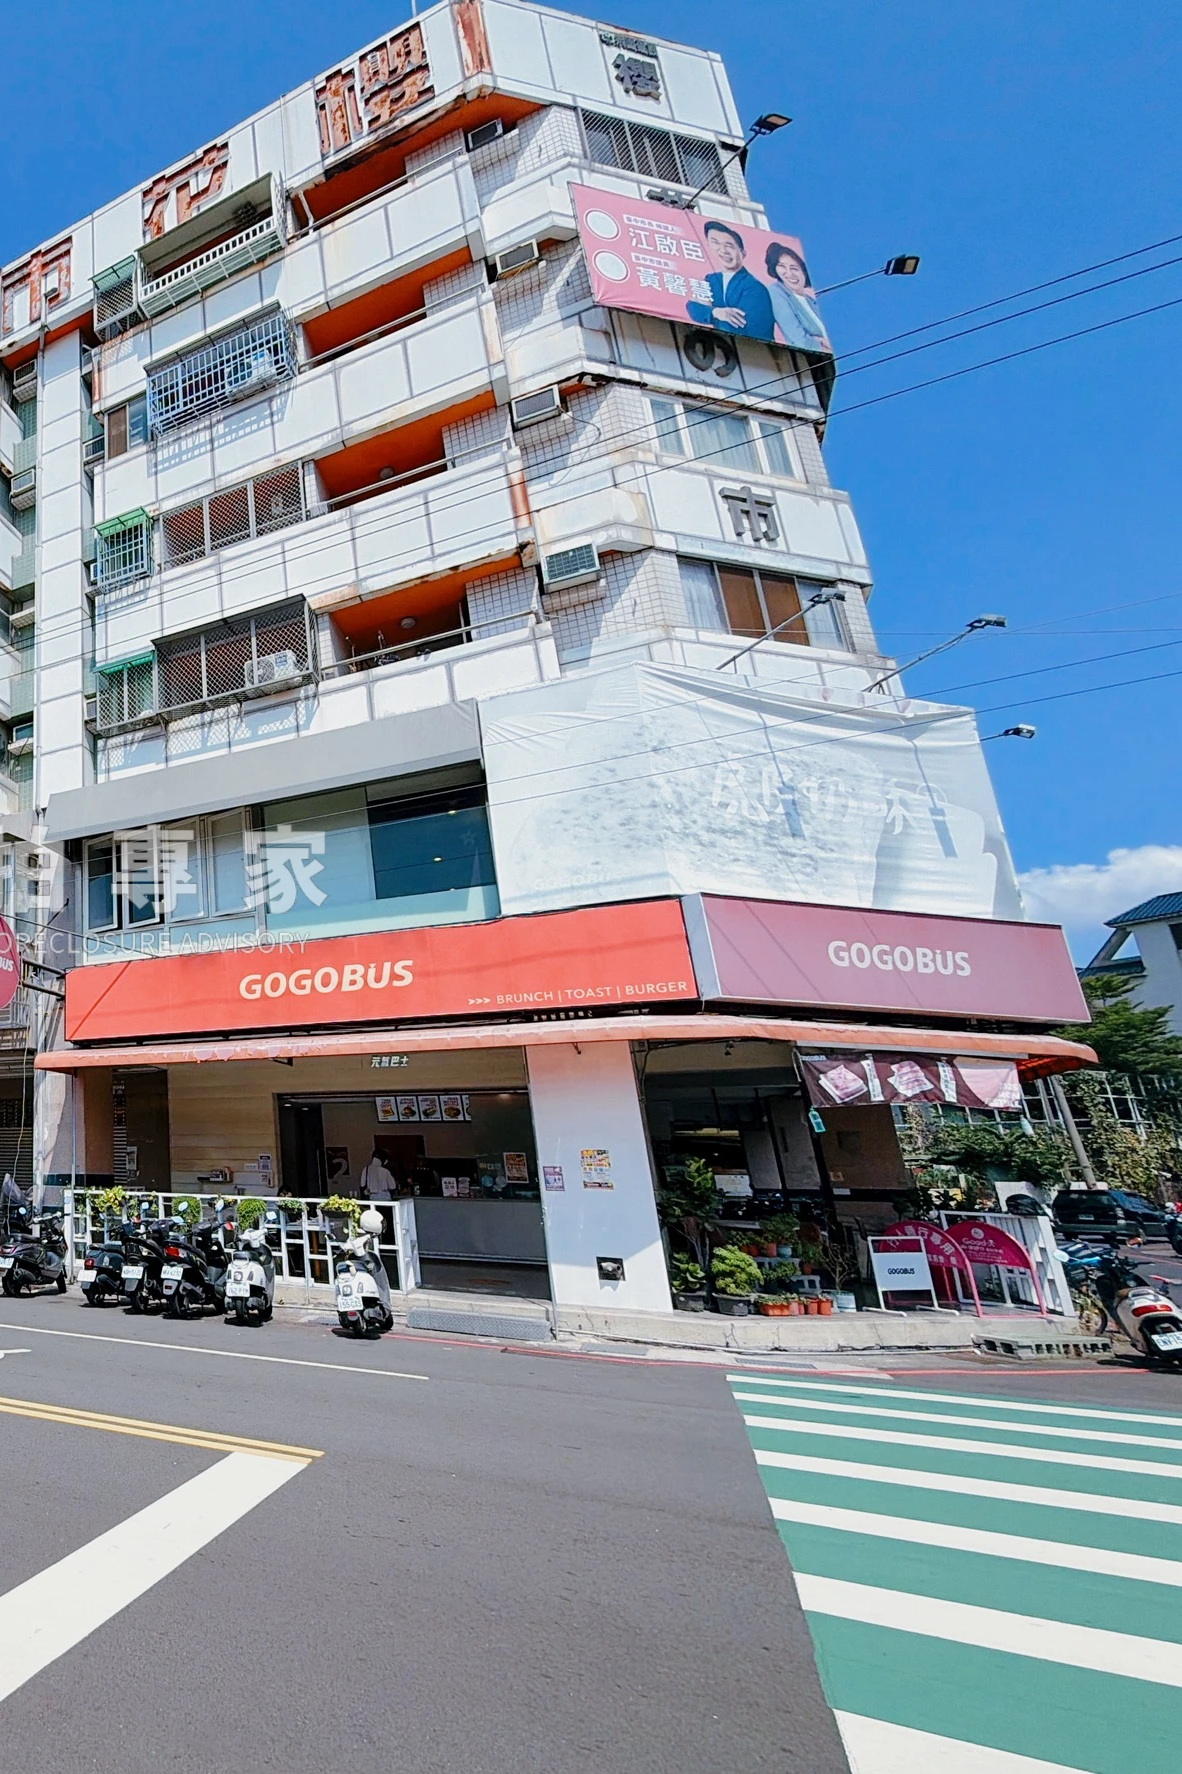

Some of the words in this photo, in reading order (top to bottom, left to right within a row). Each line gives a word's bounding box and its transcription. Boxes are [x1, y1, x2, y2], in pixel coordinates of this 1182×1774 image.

[629, 227, 706, 262] 江啟臣
[827, 940, 972, 978] GOGOBUS
[239, 958, 415, 1001] GOGOBUS
[496, 989, 554, 1005] BRUNCH
[565, 985, 612, 1000] TOAST
[626, 981, 688, 996] BURGER
[370, 1055, 410, 1068] 元氣巴士
